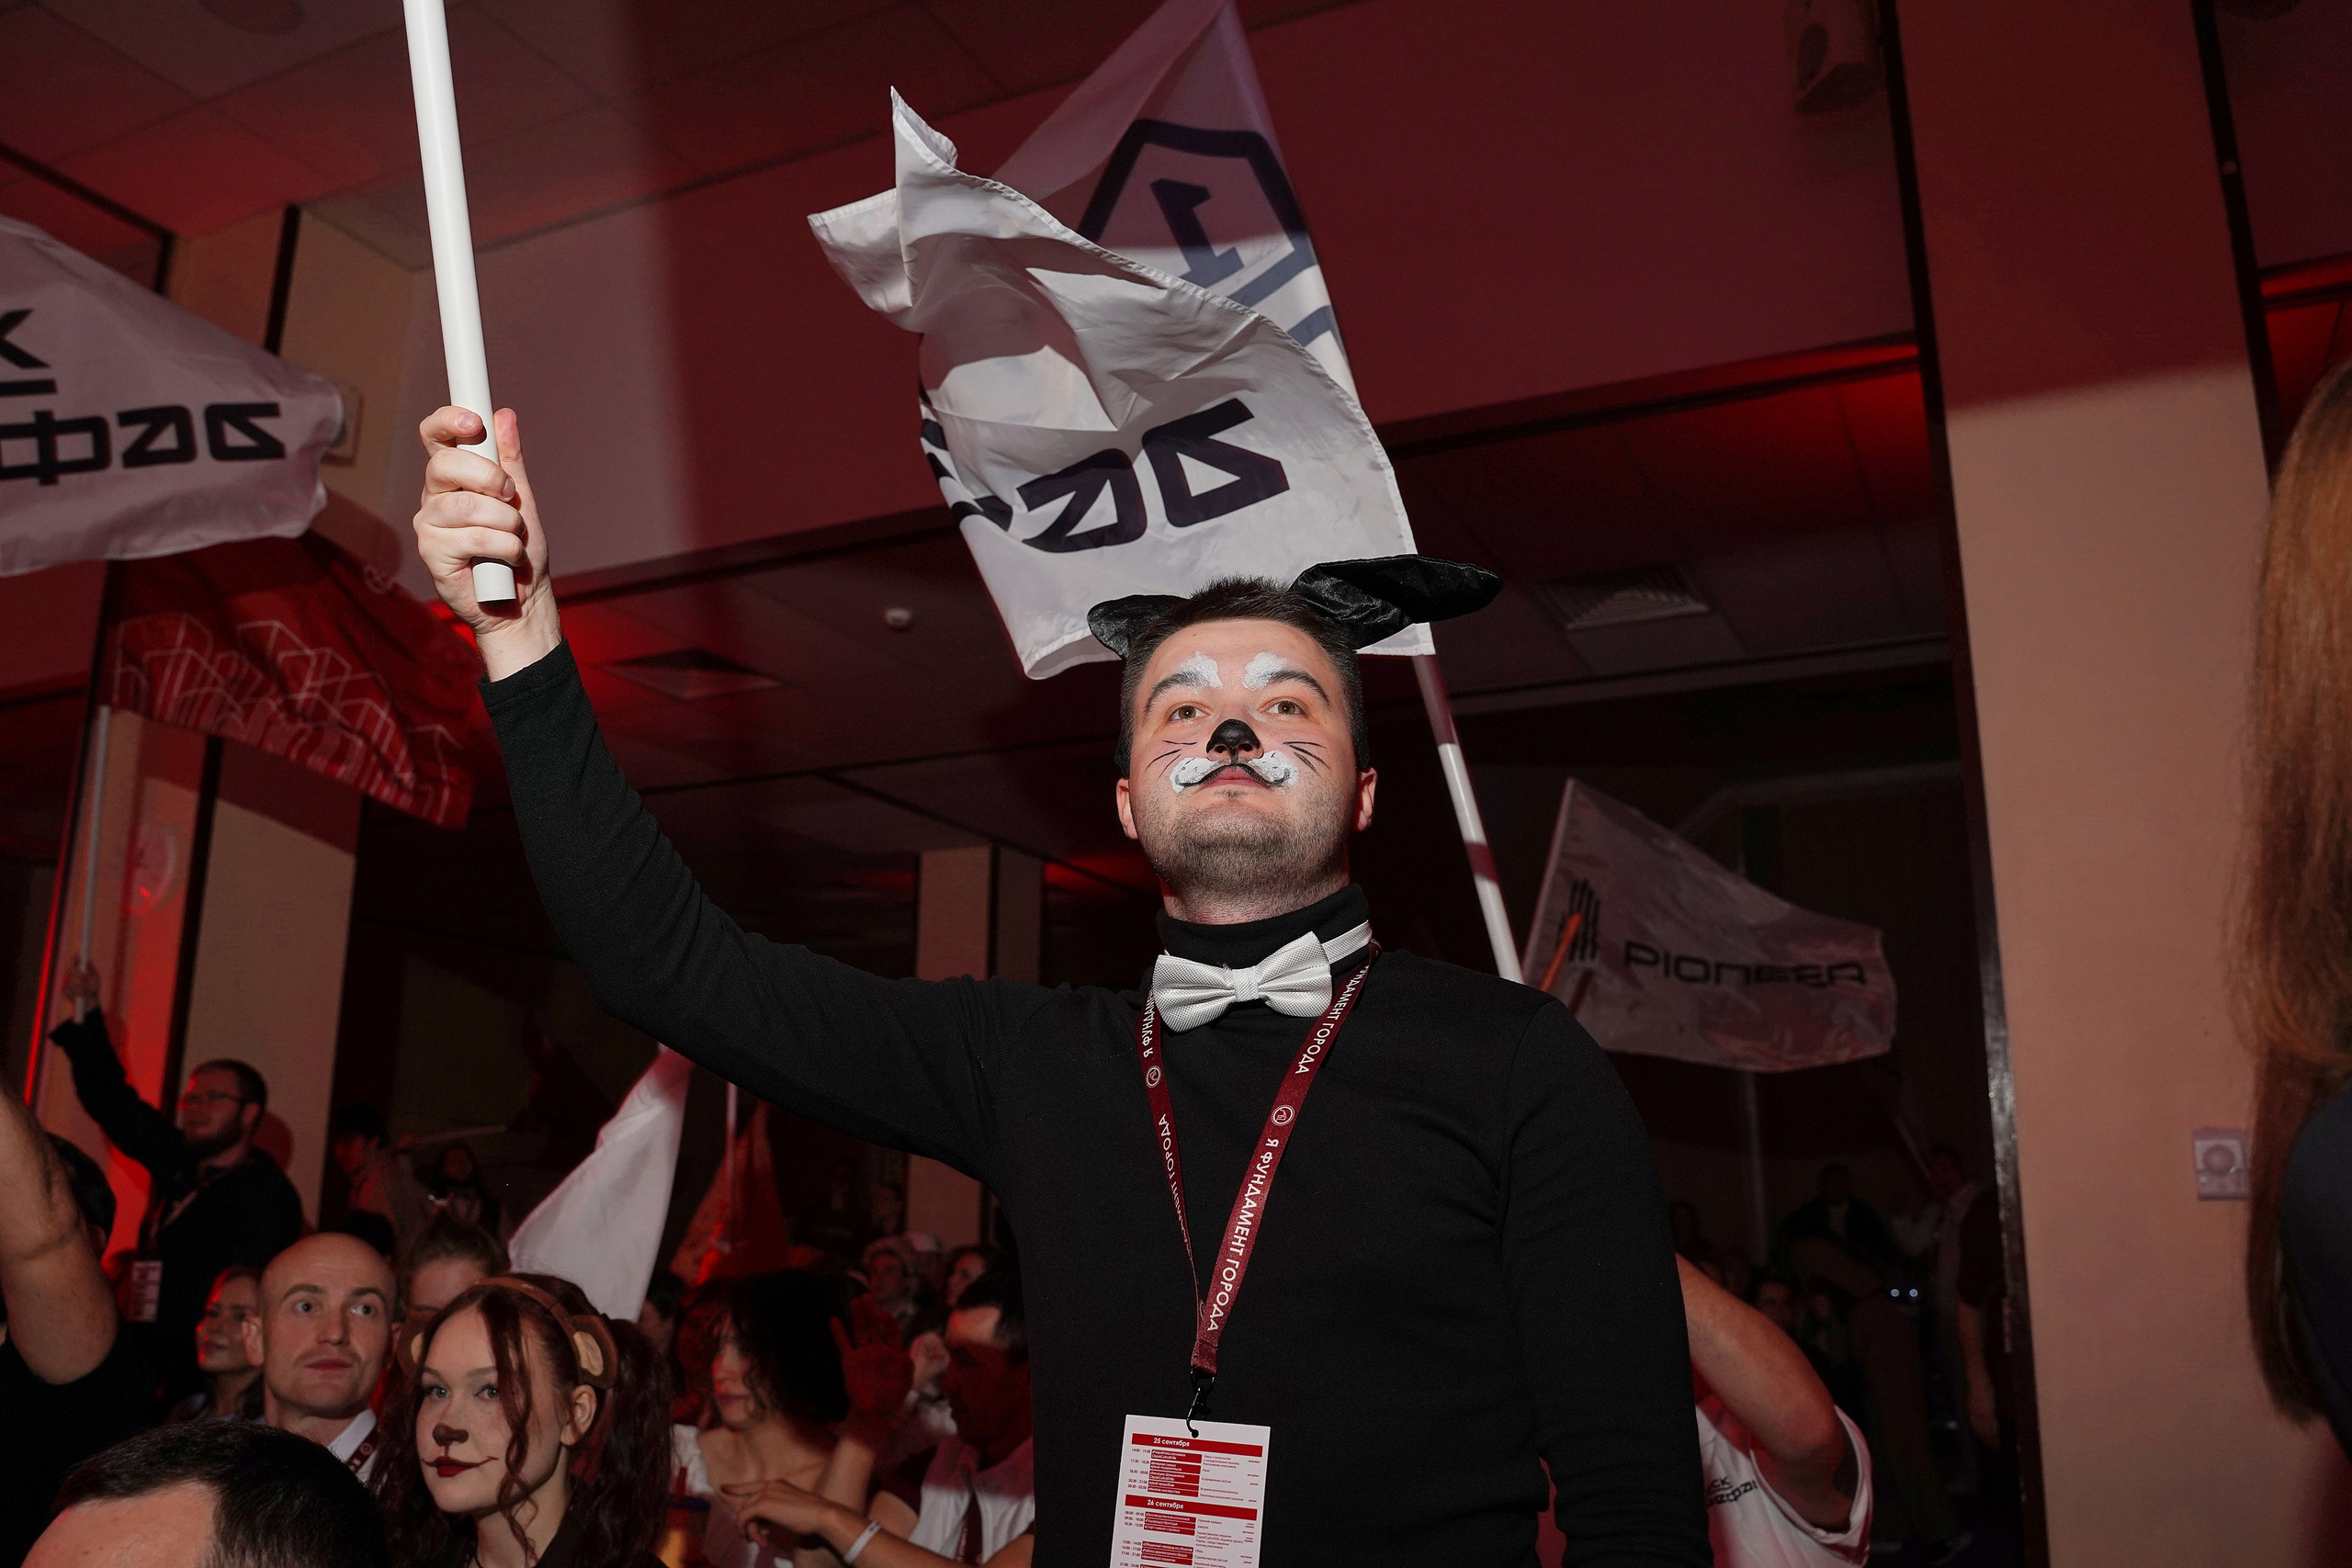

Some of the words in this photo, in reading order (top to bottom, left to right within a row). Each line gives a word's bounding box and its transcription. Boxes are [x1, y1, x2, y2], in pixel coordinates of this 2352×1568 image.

[1623, 941, 1867, 988] PIONEER
[1143, 1047, 1154, 1058] Я
[1295, 1023, 1335, 1075] ГОРОДА
[1159, 1113, 1176, 1179] ГОРОДА
[1265, 1138, 1279, 1147] Я
[1229, 1151, 1273, 1257] ФУНДАМЕНТ
[1207, 1258, 1239, 1332] ГОРОДА
[1160, 1438, 1190, 1448] сентября
[1154, 1500, 1183, 1510] сентября
